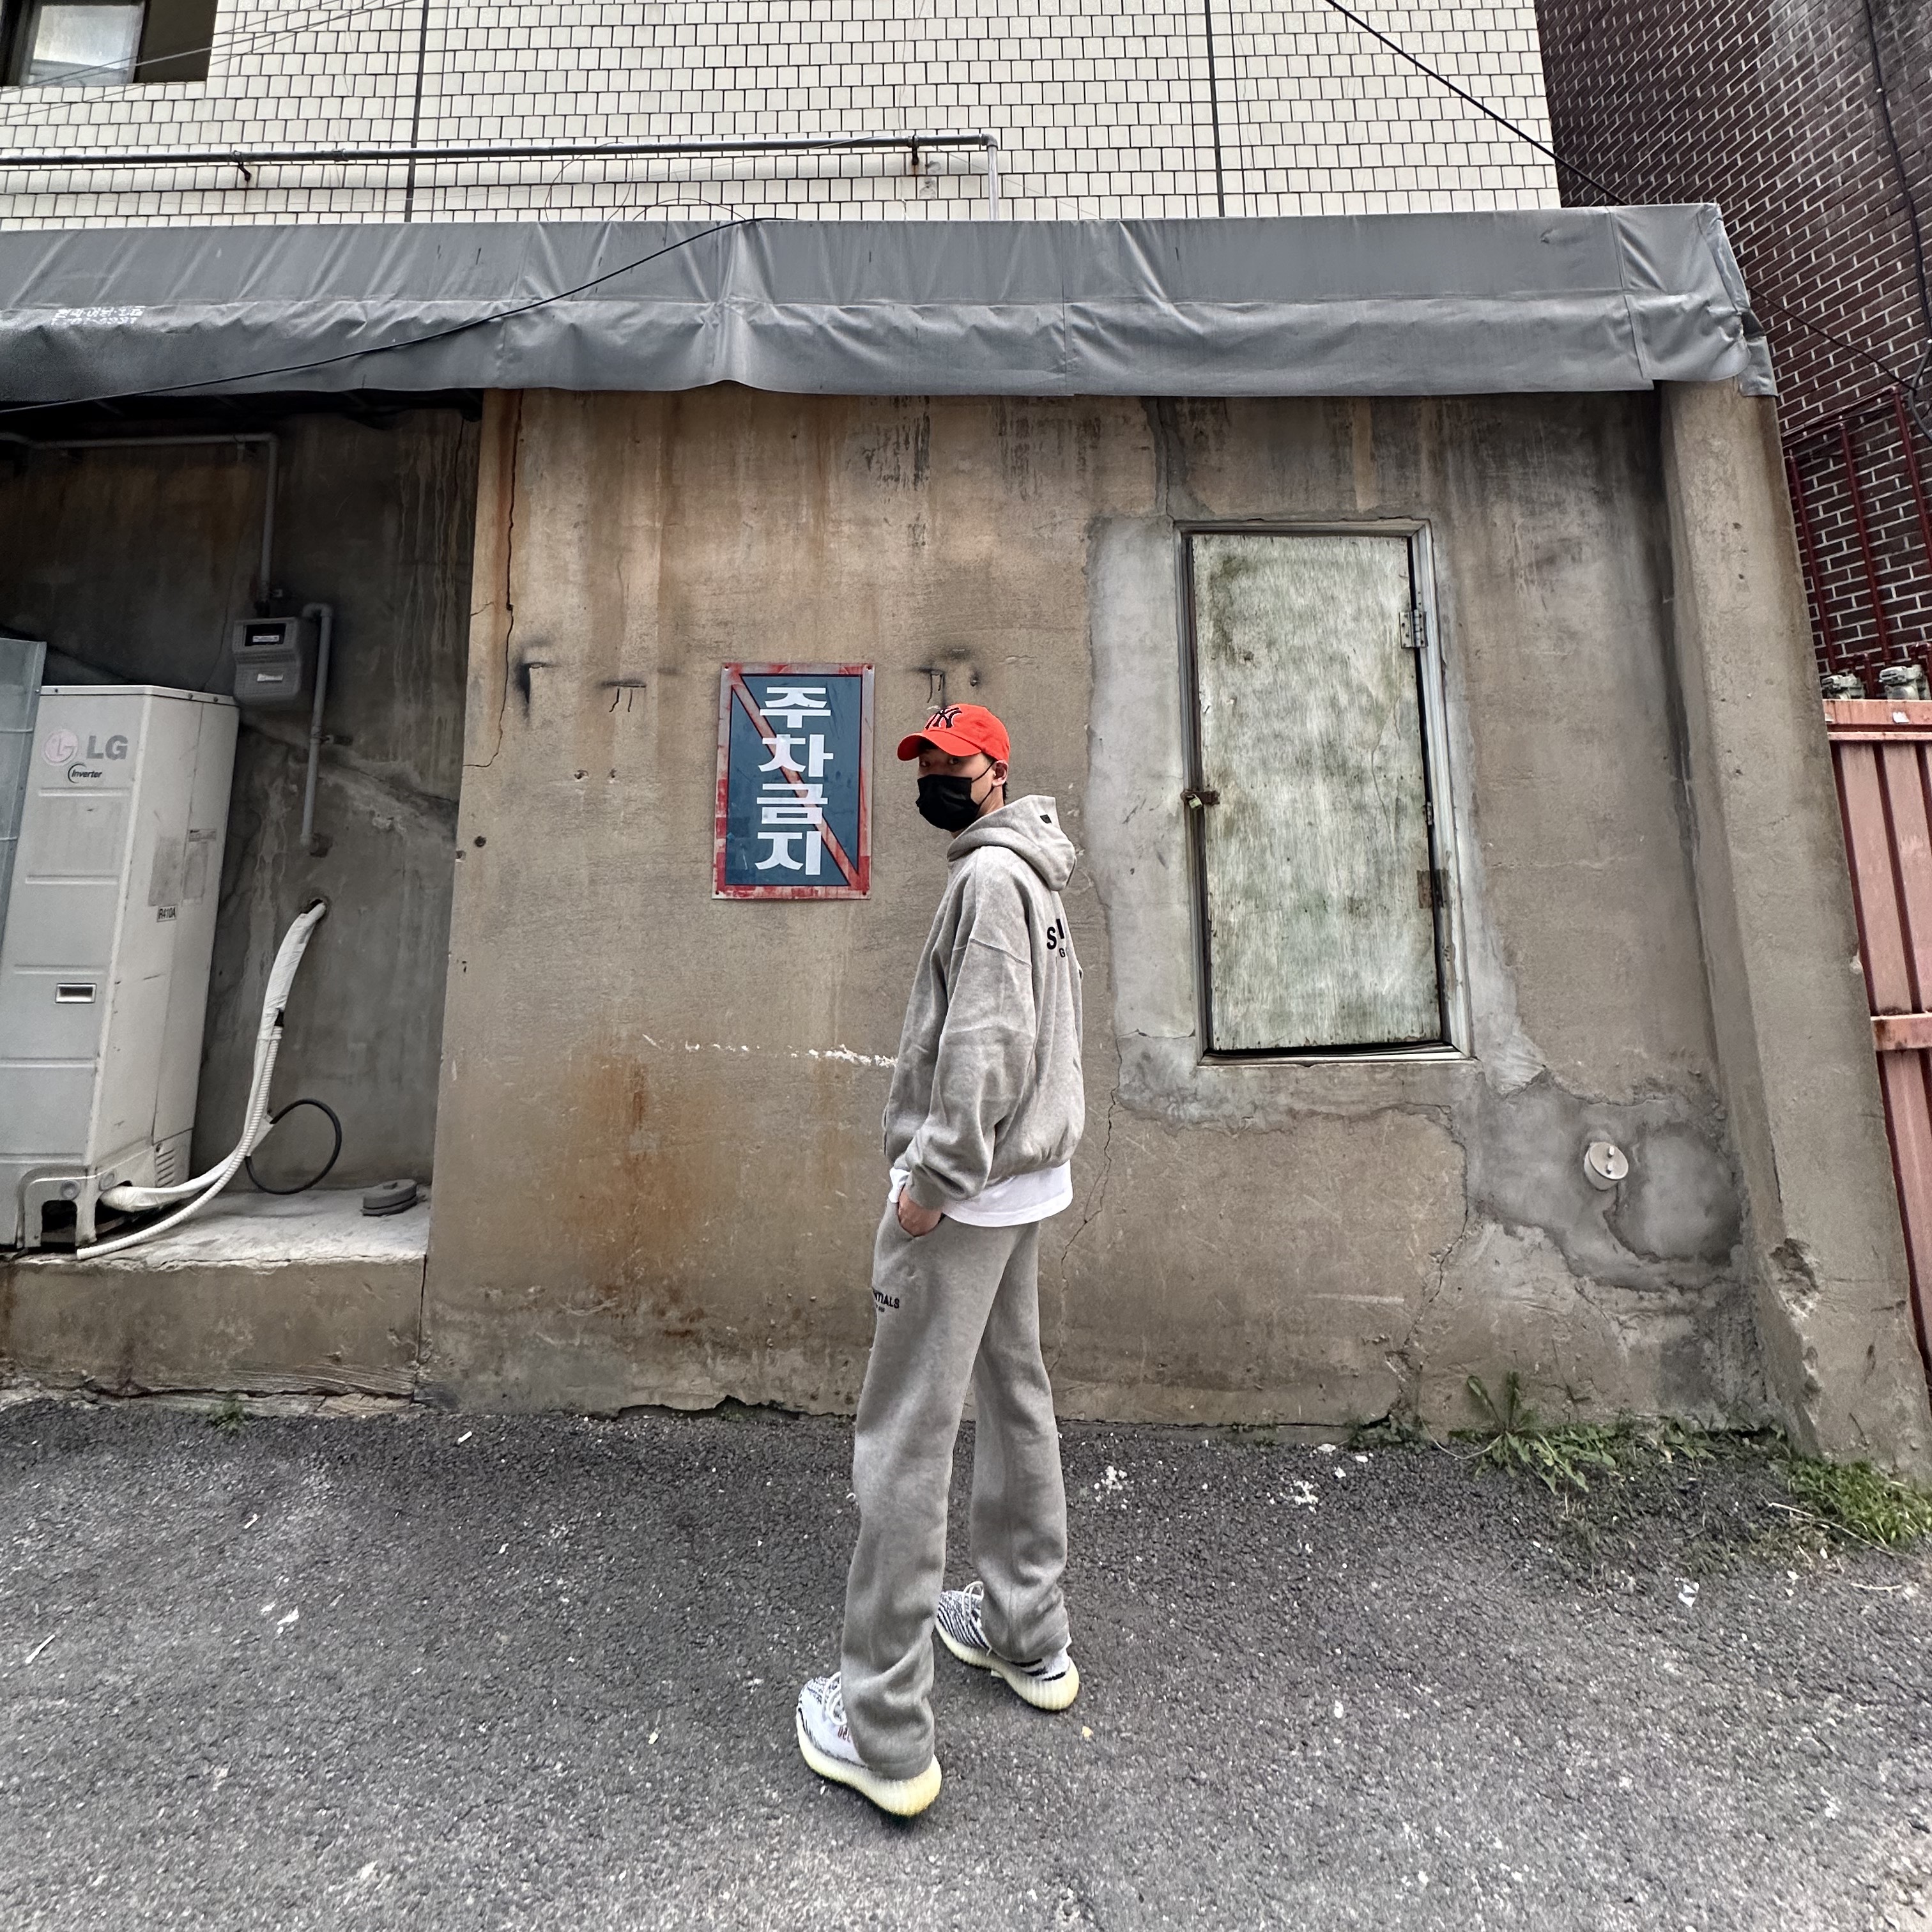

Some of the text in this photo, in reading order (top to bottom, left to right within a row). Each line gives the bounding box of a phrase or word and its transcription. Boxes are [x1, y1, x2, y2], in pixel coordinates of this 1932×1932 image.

[925, 707, 963, 730] NY
[86, 735, 128, 760] LG
[71, 769, 102, 778] Inverter
[755, 687, 834, 875] 주차금지
